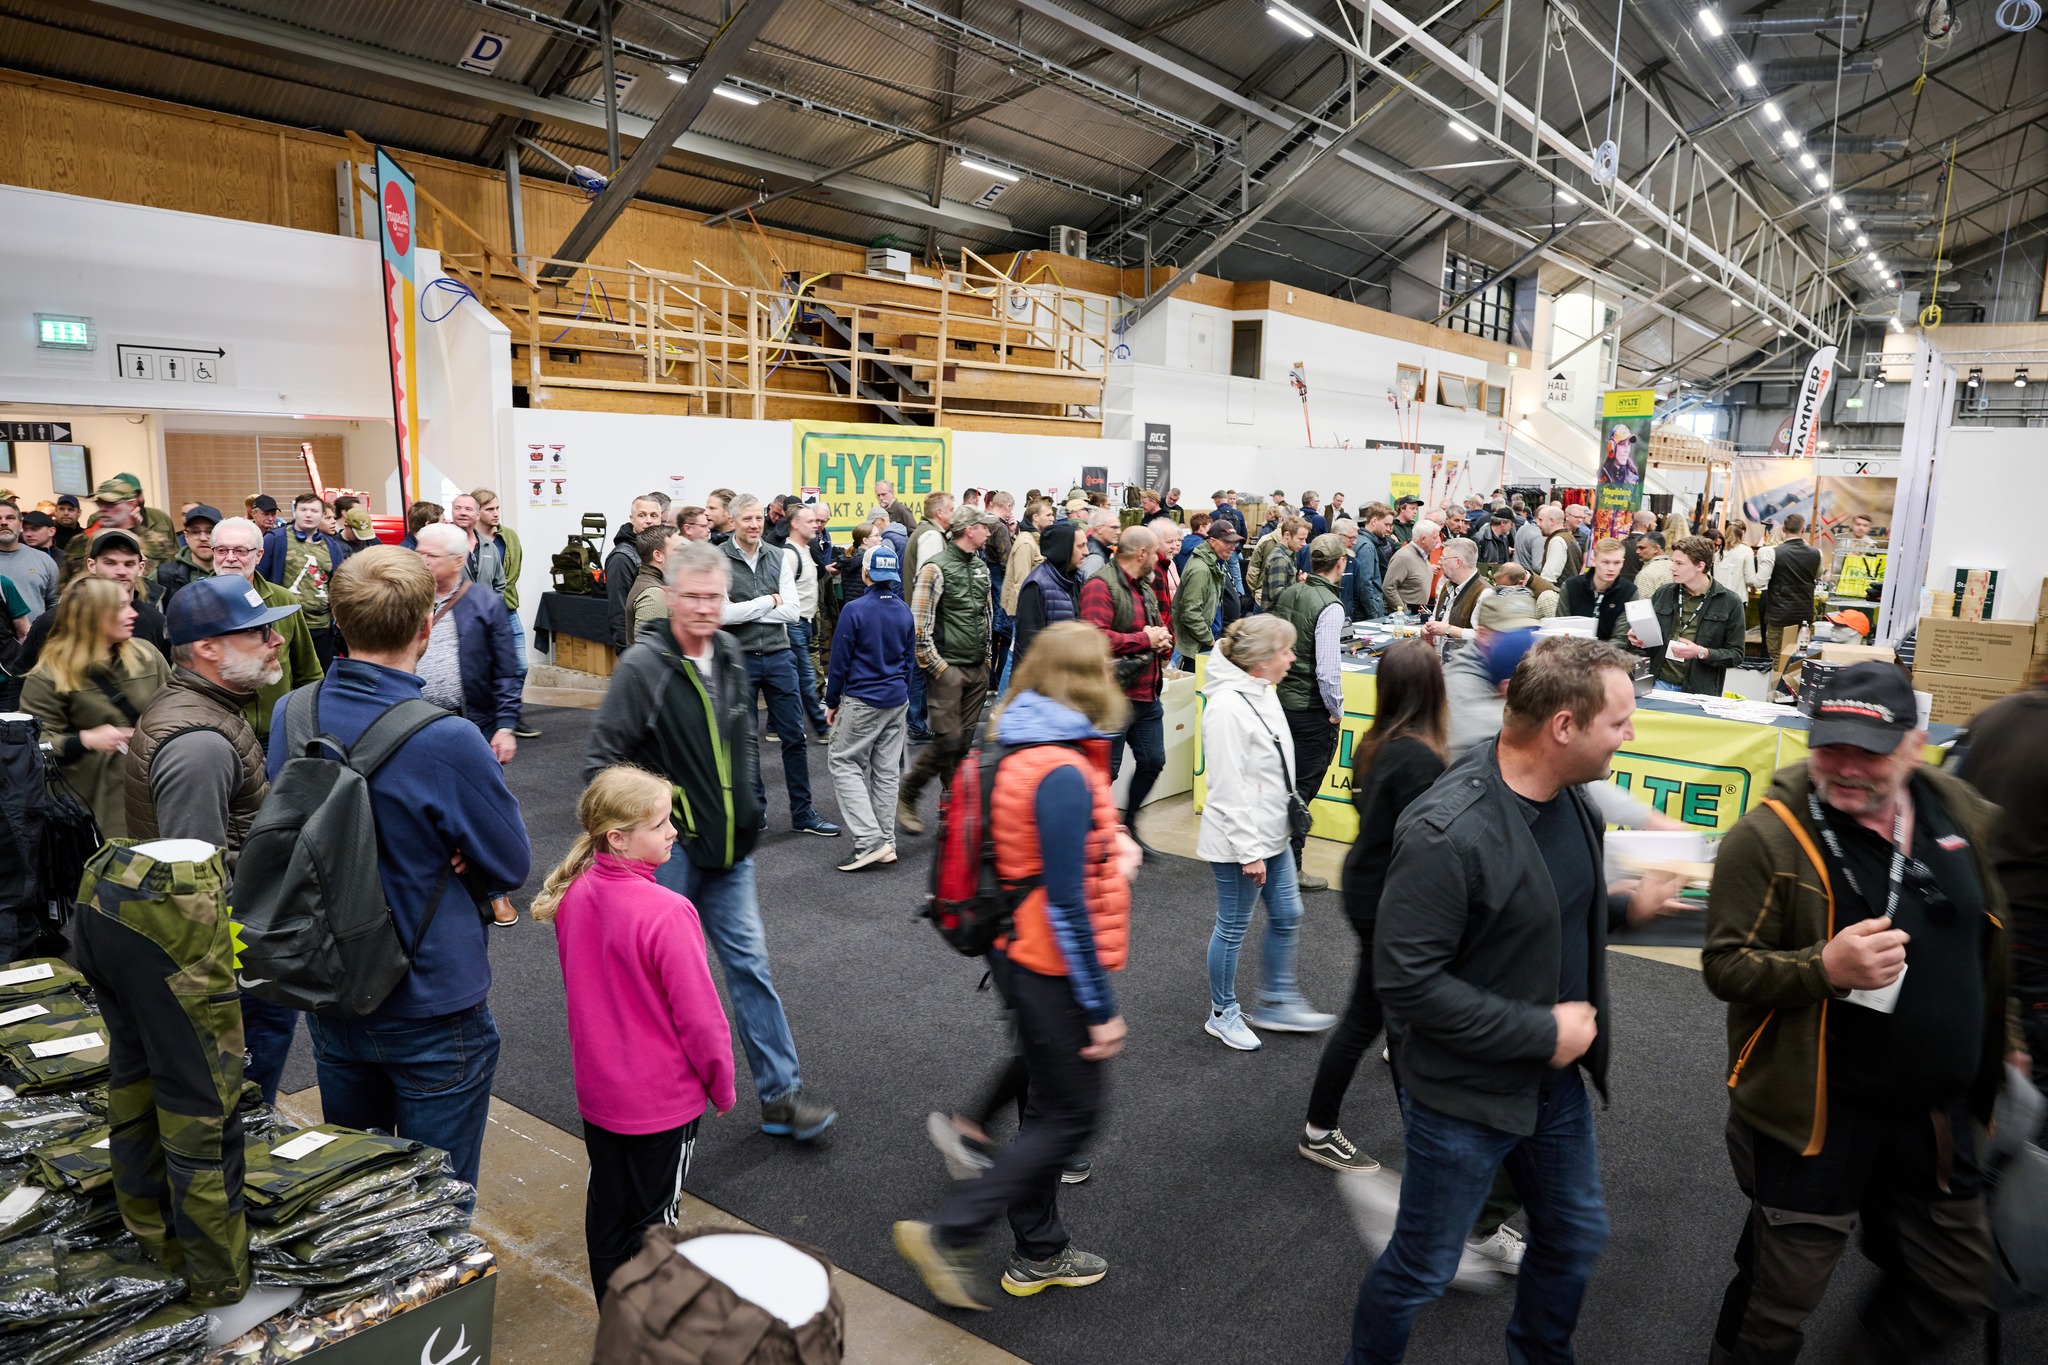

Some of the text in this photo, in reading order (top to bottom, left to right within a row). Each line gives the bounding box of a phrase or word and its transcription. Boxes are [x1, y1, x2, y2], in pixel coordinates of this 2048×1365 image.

[471, 35, 503, 61] D
[983, 185, 1004, 201] E
[1547, 382, 1569, 391] HALL
[1619, 398, 1638, 406] HYLTE
[1149, 432, 1166, 443] RCC
[1603, 487, 1631, 497] Magdalena
[1604, 497, 1628, 507] Forsberg
[828, 503, 850, 517] AKT
[855, 502, 864, 517] &
